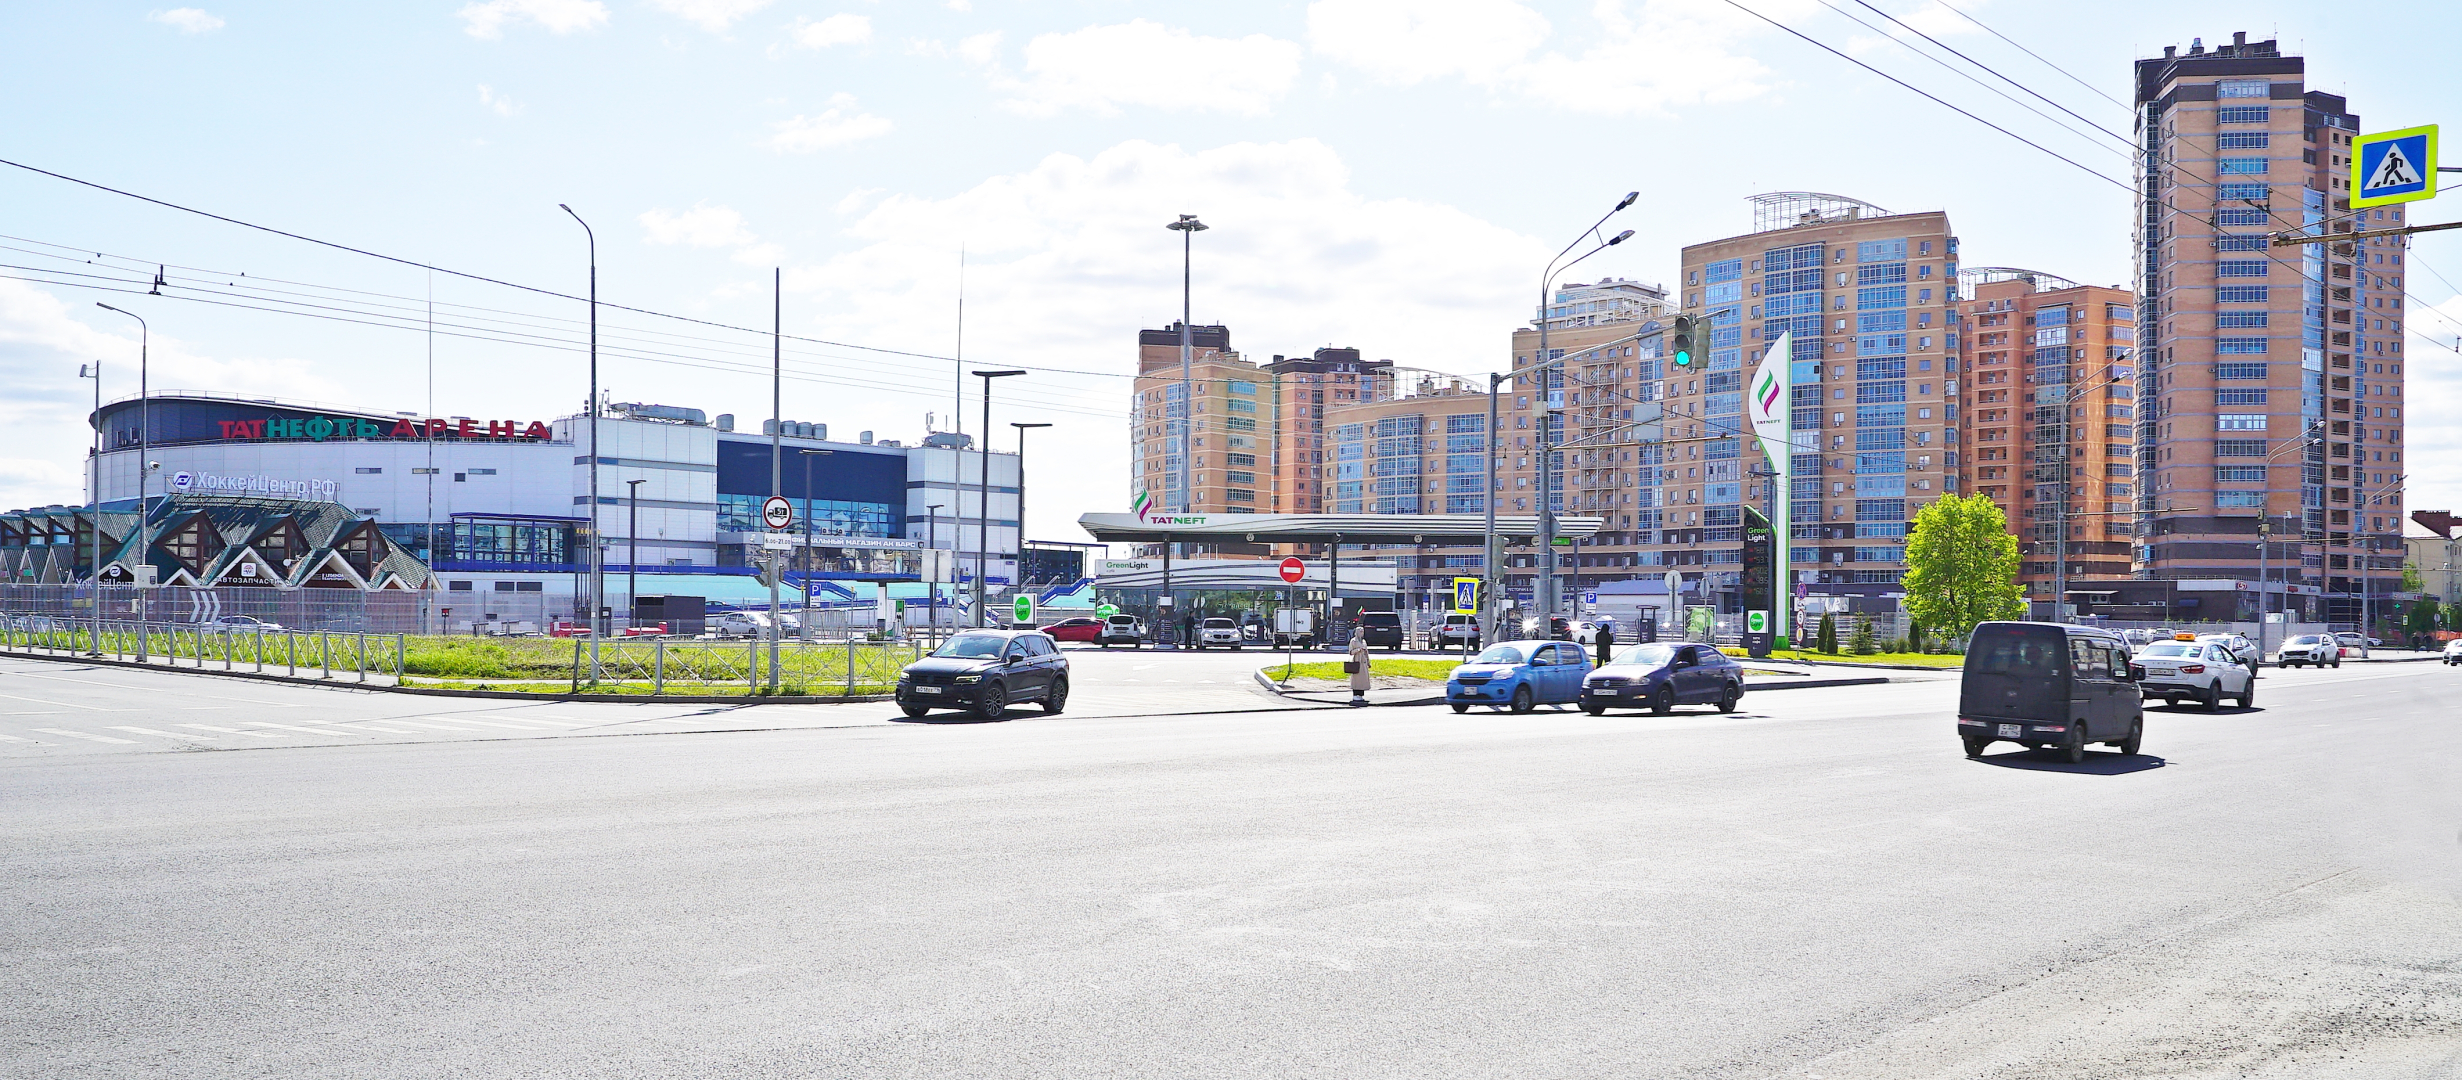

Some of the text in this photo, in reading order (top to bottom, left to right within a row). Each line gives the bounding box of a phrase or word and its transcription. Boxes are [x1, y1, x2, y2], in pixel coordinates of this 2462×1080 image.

[218, 416, 551, 442] ТАТНЕФТЬ АРЕНА
[196, 471, 337, 497] ХоккейЦентр.РФ
[792, 537, 844, 545] ФИЦИАЛЬНЫЙ
[1747, 534, 1766, 542] Light
[1106, 562, 1149, 570] GreenLight
